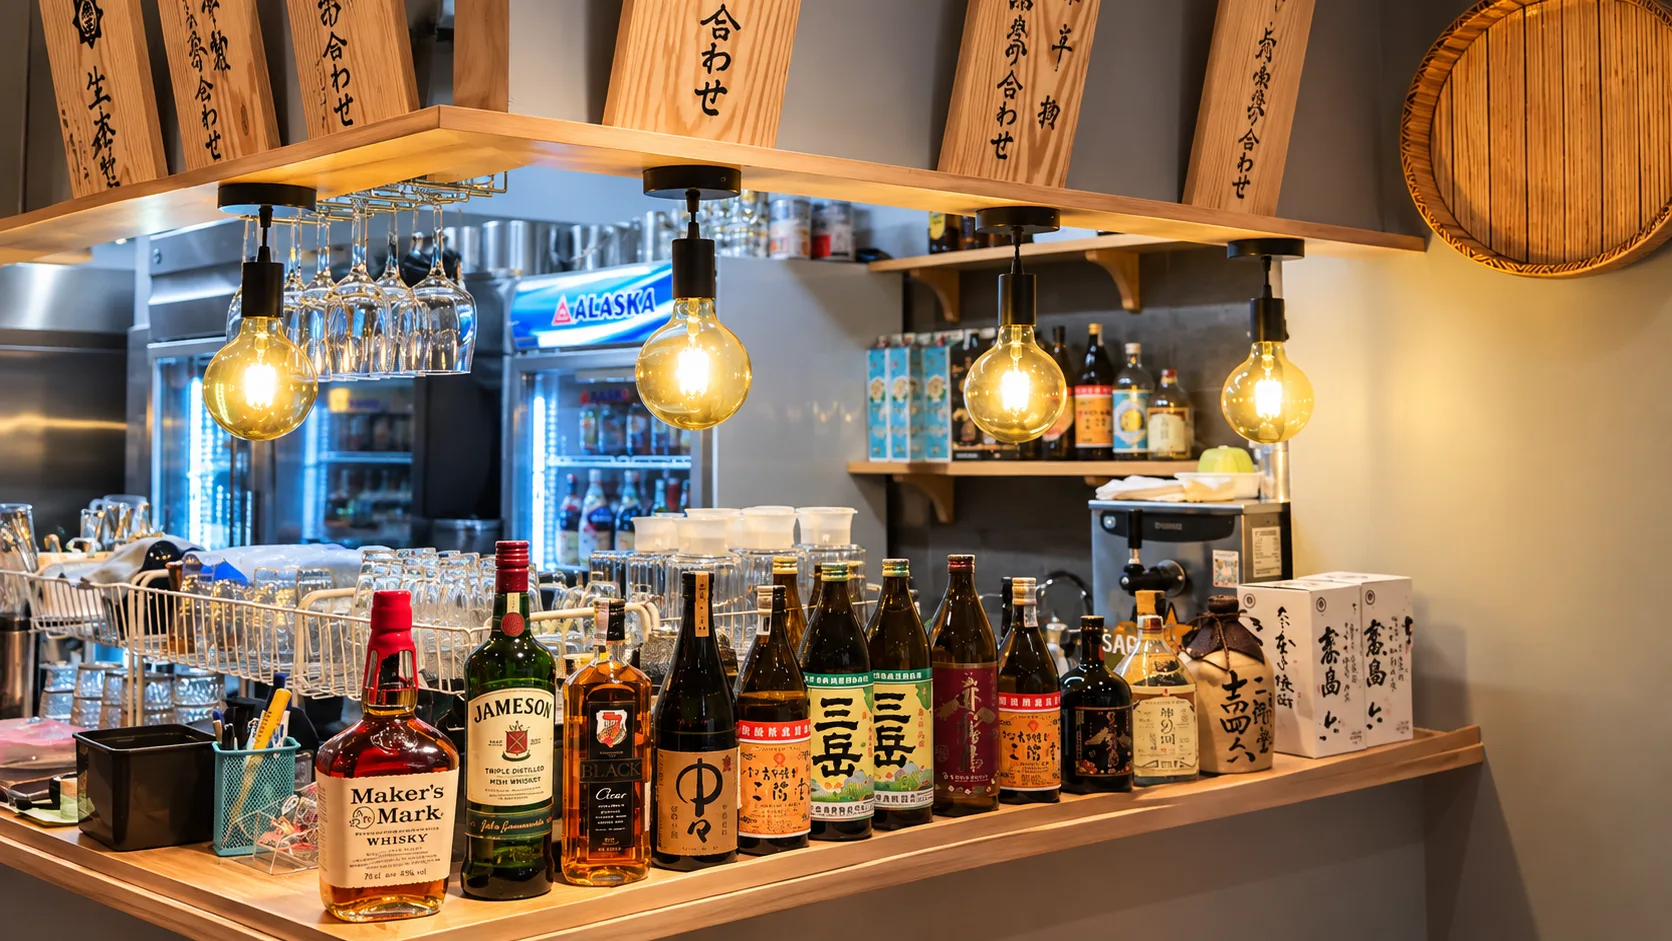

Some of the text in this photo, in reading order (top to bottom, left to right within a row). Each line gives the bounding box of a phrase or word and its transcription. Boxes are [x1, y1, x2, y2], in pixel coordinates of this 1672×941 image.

[694, 3, 741, 116] 合わせ
[574, 287, 656, 320] ALASKA
[474, 697, 552, 723] JAMESON
[811, 697, 863, 778] 三岳
[873, 692, 916, 768] 三岳
[581, 762, 640, 778] BLACK
[350, 784, 445, 804] Maker's
[377, 805, 441, 825] Mark
[367, 833, 428, 846] WHISKY
